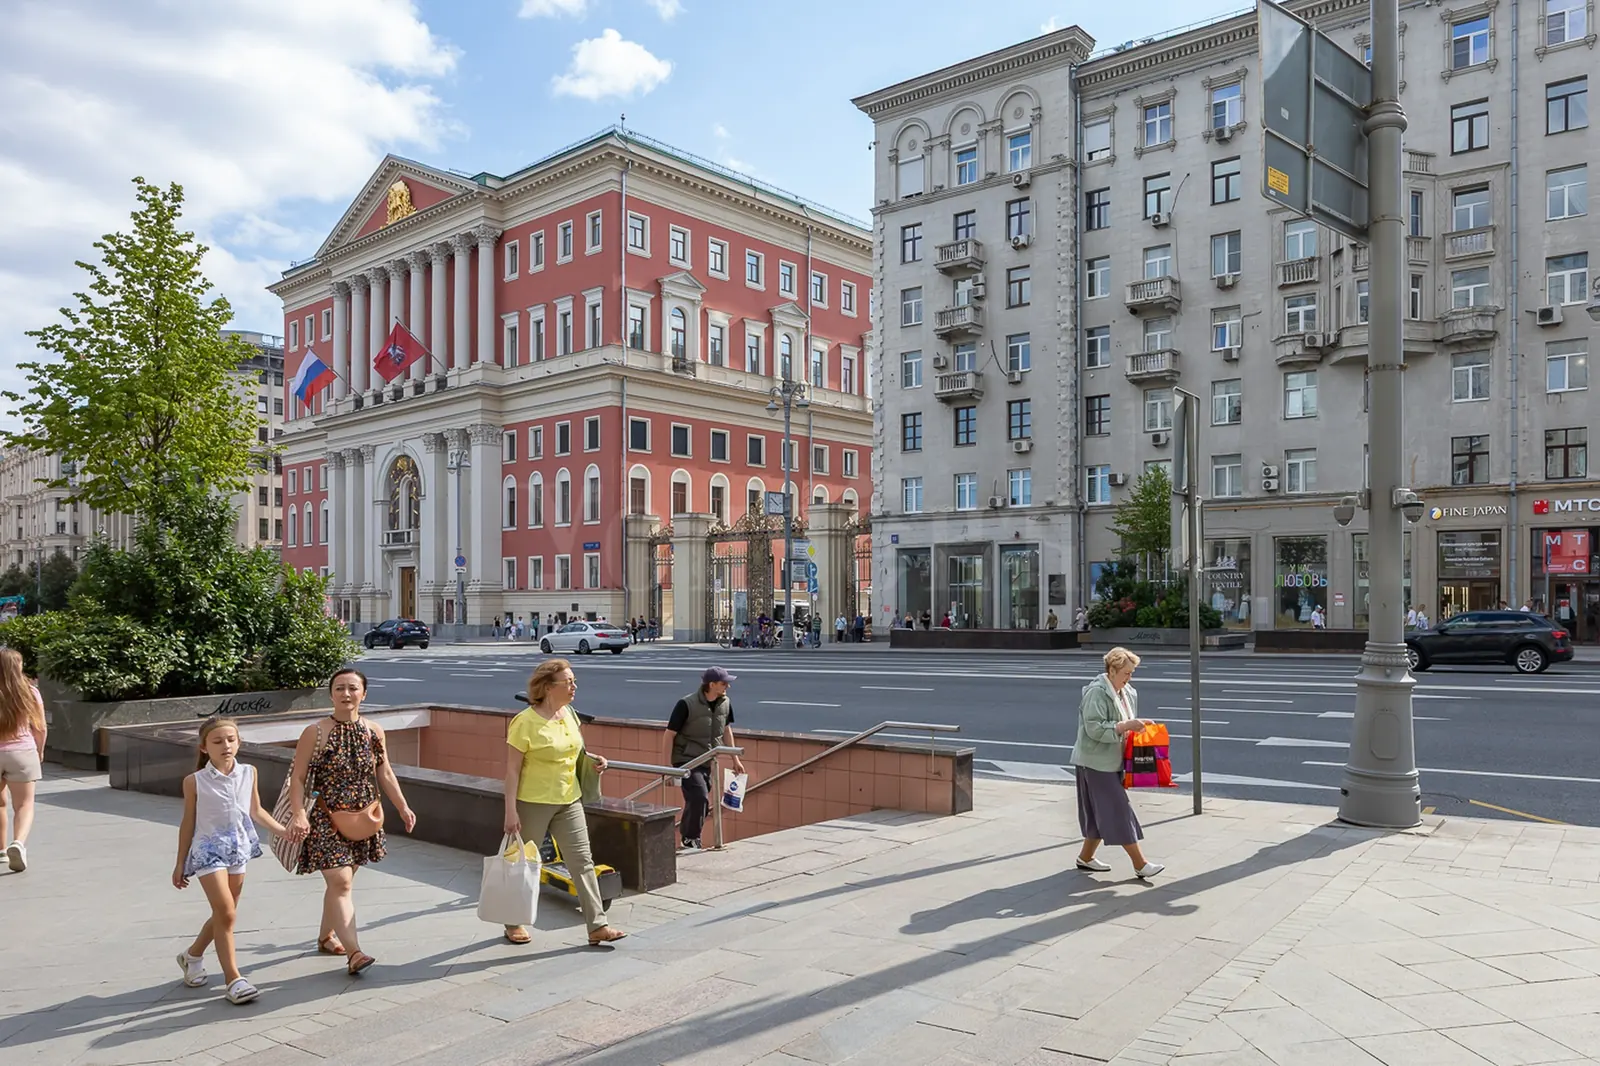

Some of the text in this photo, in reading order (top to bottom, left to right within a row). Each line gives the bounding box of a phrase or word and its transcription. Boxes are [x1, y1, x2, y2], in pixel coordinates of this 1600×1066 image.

[1443, 505, 1507, 517] FINE JAPAN
[1297, 563, 1312, 572] НАС
[1207, 572, 1245, 580] COUNTRY
[1276, 574, 1328, 587] ЛЮБОВЬ
[198, 697, 272, 717] Москва
